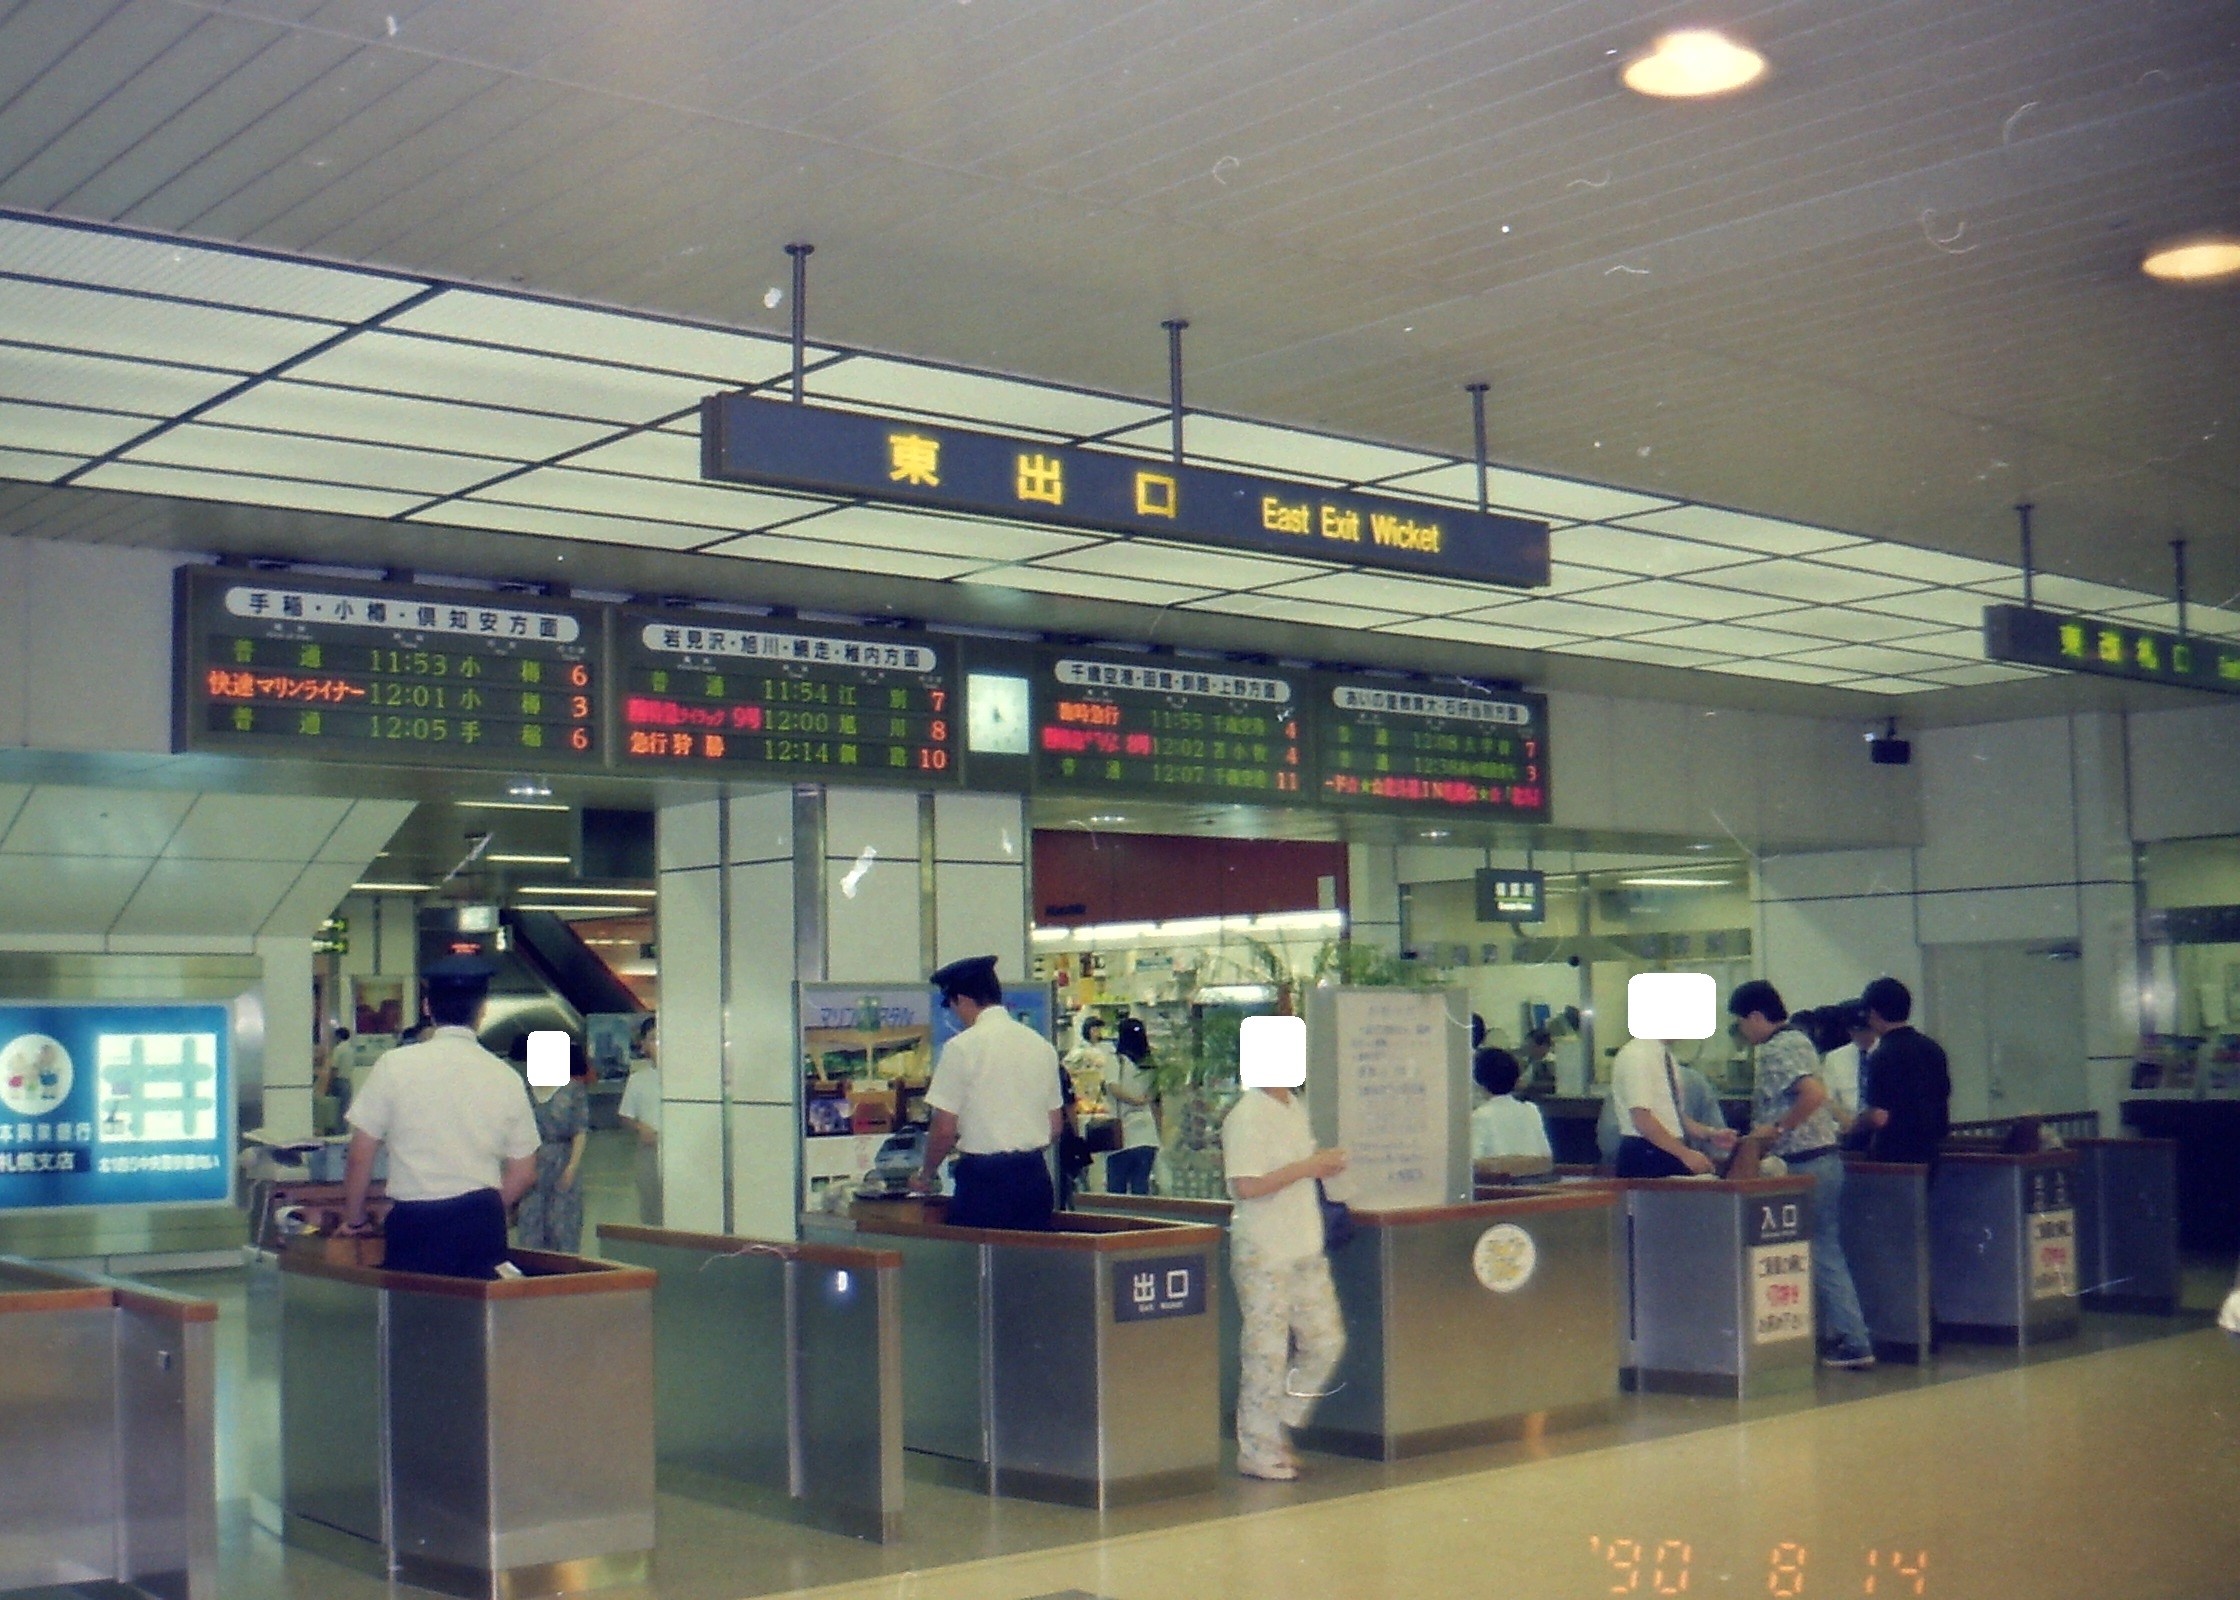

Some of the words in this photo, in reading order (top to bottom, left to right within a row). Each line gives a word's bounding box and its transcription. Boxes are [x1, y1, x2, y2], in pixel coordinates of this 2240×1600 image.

[889, 433, 1178, 518] 東出口
[1262, 496, 1310, 535] East
[1320, 505, 1361, 542] Exit
[1369, 512, 1441, 553] Wicket
[370, 650, 448, 677] 11:53
[571, 665, 589, 687] 6
[370, 682, 447, 709] 12:01
[571, 695, 590, 718] 3
[763, 680, 829, 704] 11:54
[930, 691, 947, 712] 7
[370, 714, 447, 741] 12:05
[571, 728, 589, 751] 6
[764, 709, 829, 733] 12:00
[930, 720, 948, 741] 8
[764, 739, 829, 764] 12:14
[919, 747, 949, 770] 10
[1525, 740, 1537, 759] 7
[1276, 771, 1298, 791] 11
[1761, 1204, 1797, 1231] 入口
[1133, 1269, 1189, 1303] 出口
